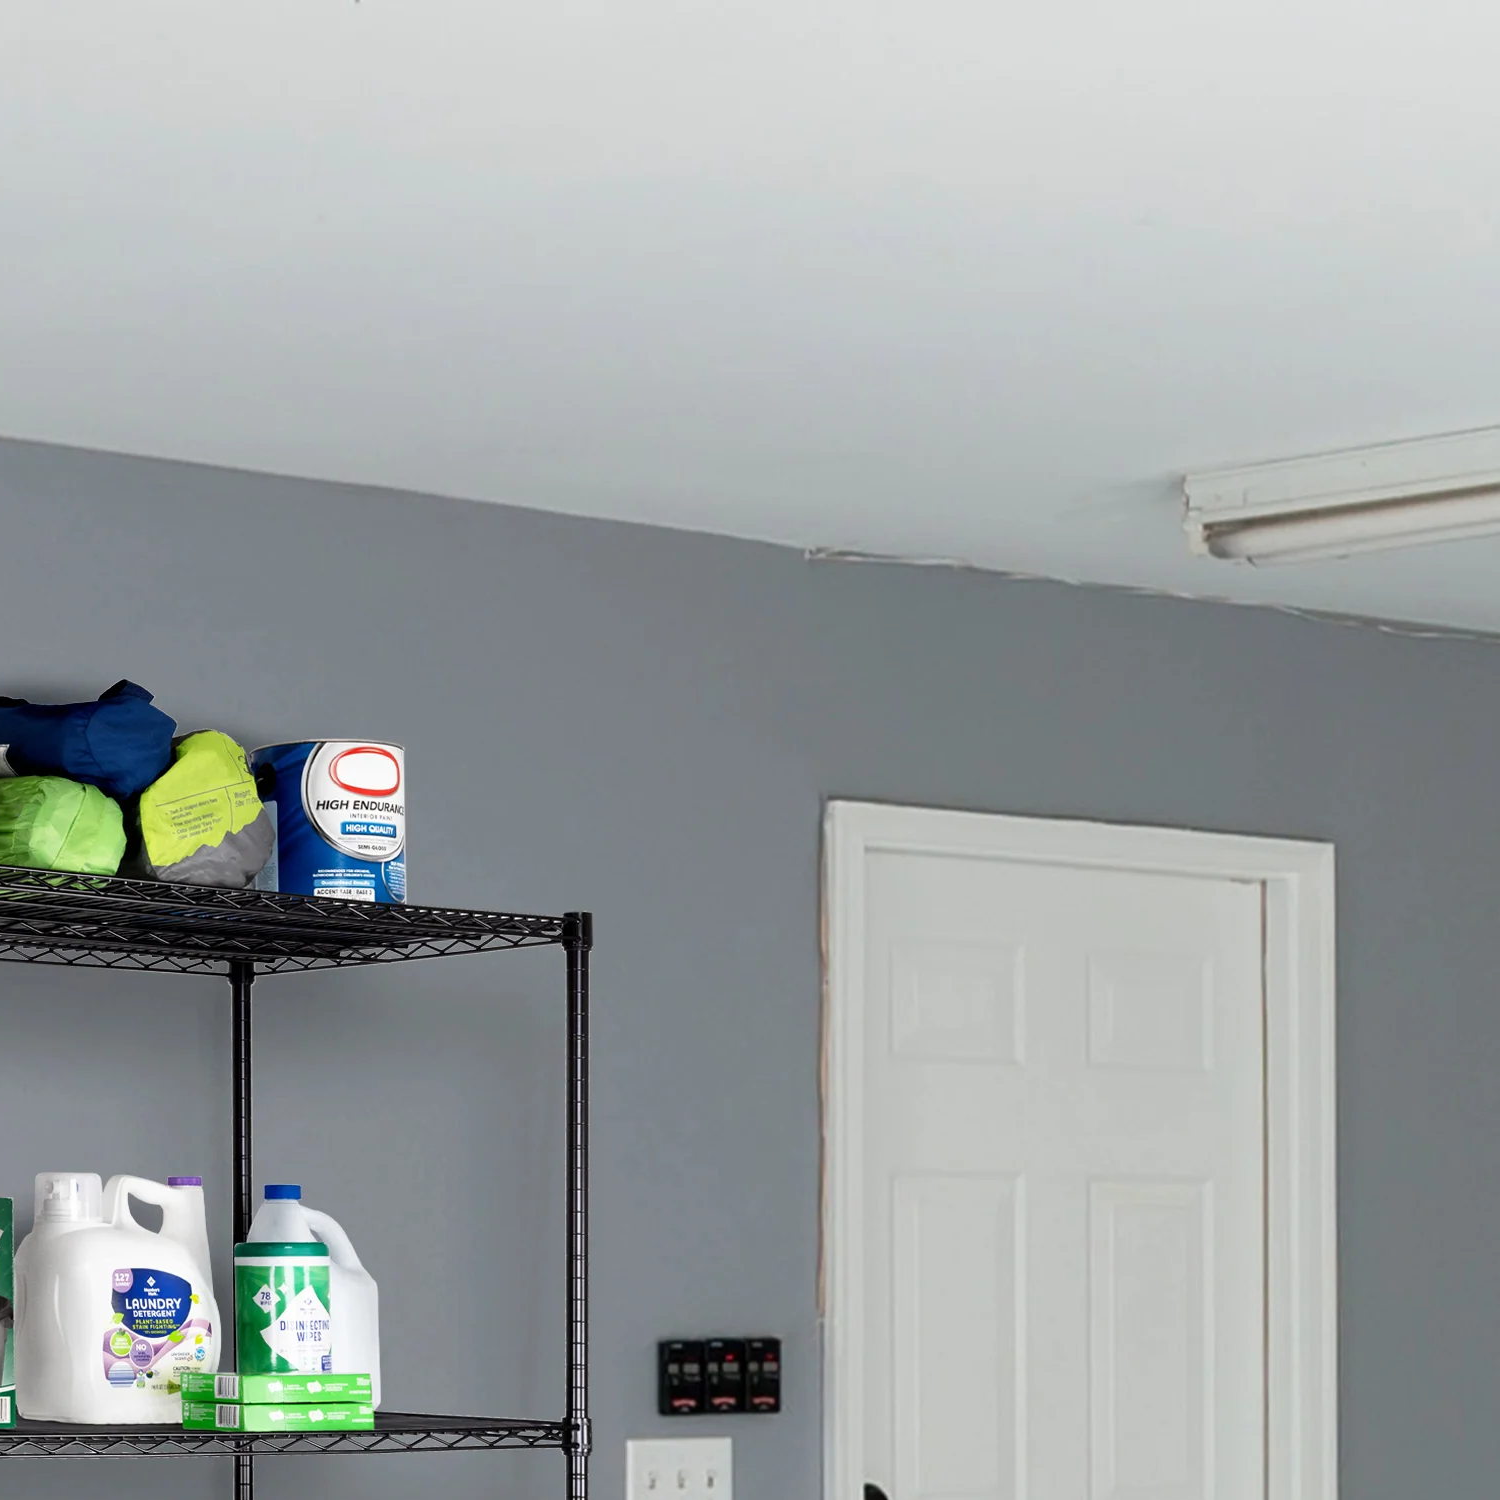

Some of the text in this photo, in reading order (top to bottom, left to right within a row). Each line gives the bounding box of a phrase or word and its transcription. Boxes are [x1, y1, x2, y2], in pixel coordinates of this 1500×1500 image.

[316, 800, 349, 810] HIGH
[346, 824, 394, 835] HIGH QUALITY
[114, 1273, 130, 1281] 127
[260, 1291, 271, 1300] 78
[125, 1298, 182, 1310] LAUNDRY
[133, 1310, 176, 1318] DETERGENT
[296, 1332, 322, 1342] WIPES
